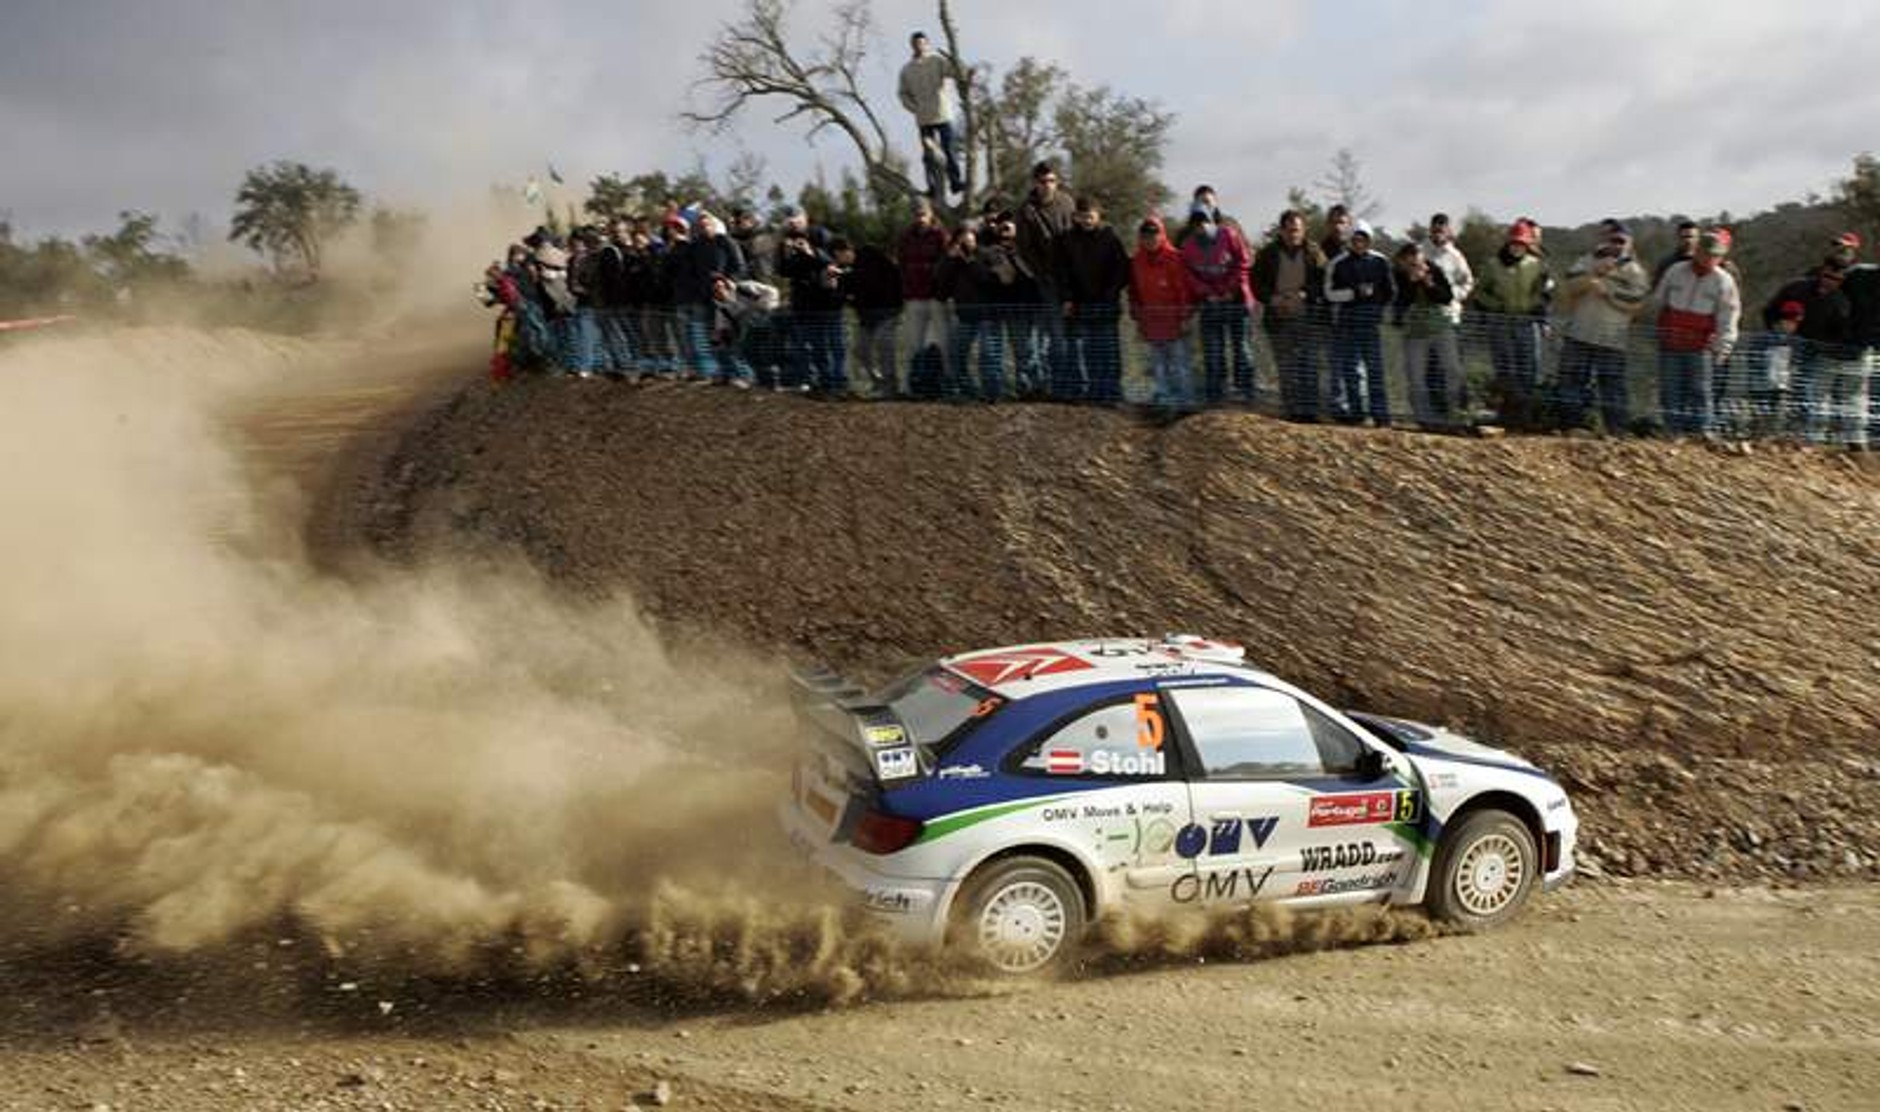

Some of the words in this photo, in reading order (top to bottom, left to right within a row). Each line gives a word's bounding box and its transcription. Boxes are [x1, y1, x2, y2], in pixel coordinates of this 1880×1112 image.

[1135, 693, 1165, 748] 5
[1090, 750, 1166, 775] Stohl
[1043, 808, 1077, 821] OMV
[1083, 805, 1120, 817] Move
[1126, 802, 1136, 815] &
[1400, 791, 1414, 821] 5
[1171, 866, 1274, 903] OMV
